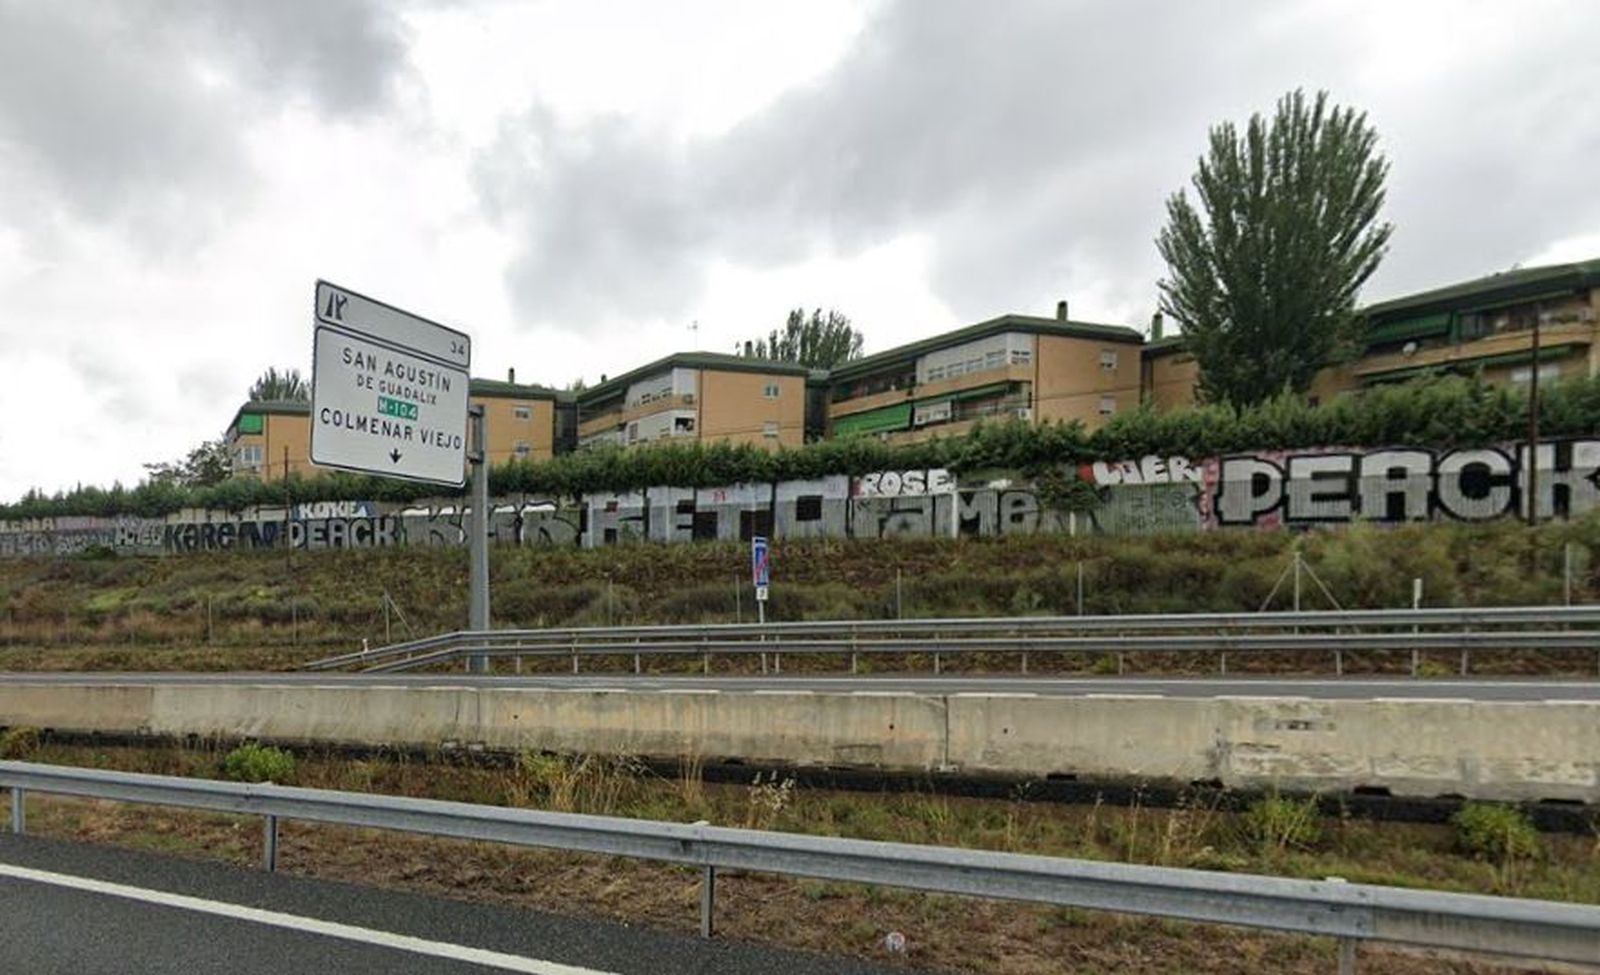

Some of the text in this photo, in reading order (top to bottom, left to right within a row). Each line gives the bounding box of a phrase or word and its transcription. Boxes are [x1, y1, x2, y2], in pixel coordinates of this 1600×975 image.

[451, 341, 465, 355] 34
[342, 347, 451, 392] SAN AGUSTÍN
[356, 375, 437, 405] DE GUADALIX
[320, 407, 462, 449] COLMENAR VIEJO
[859, 468, 956, 497] ROSE
